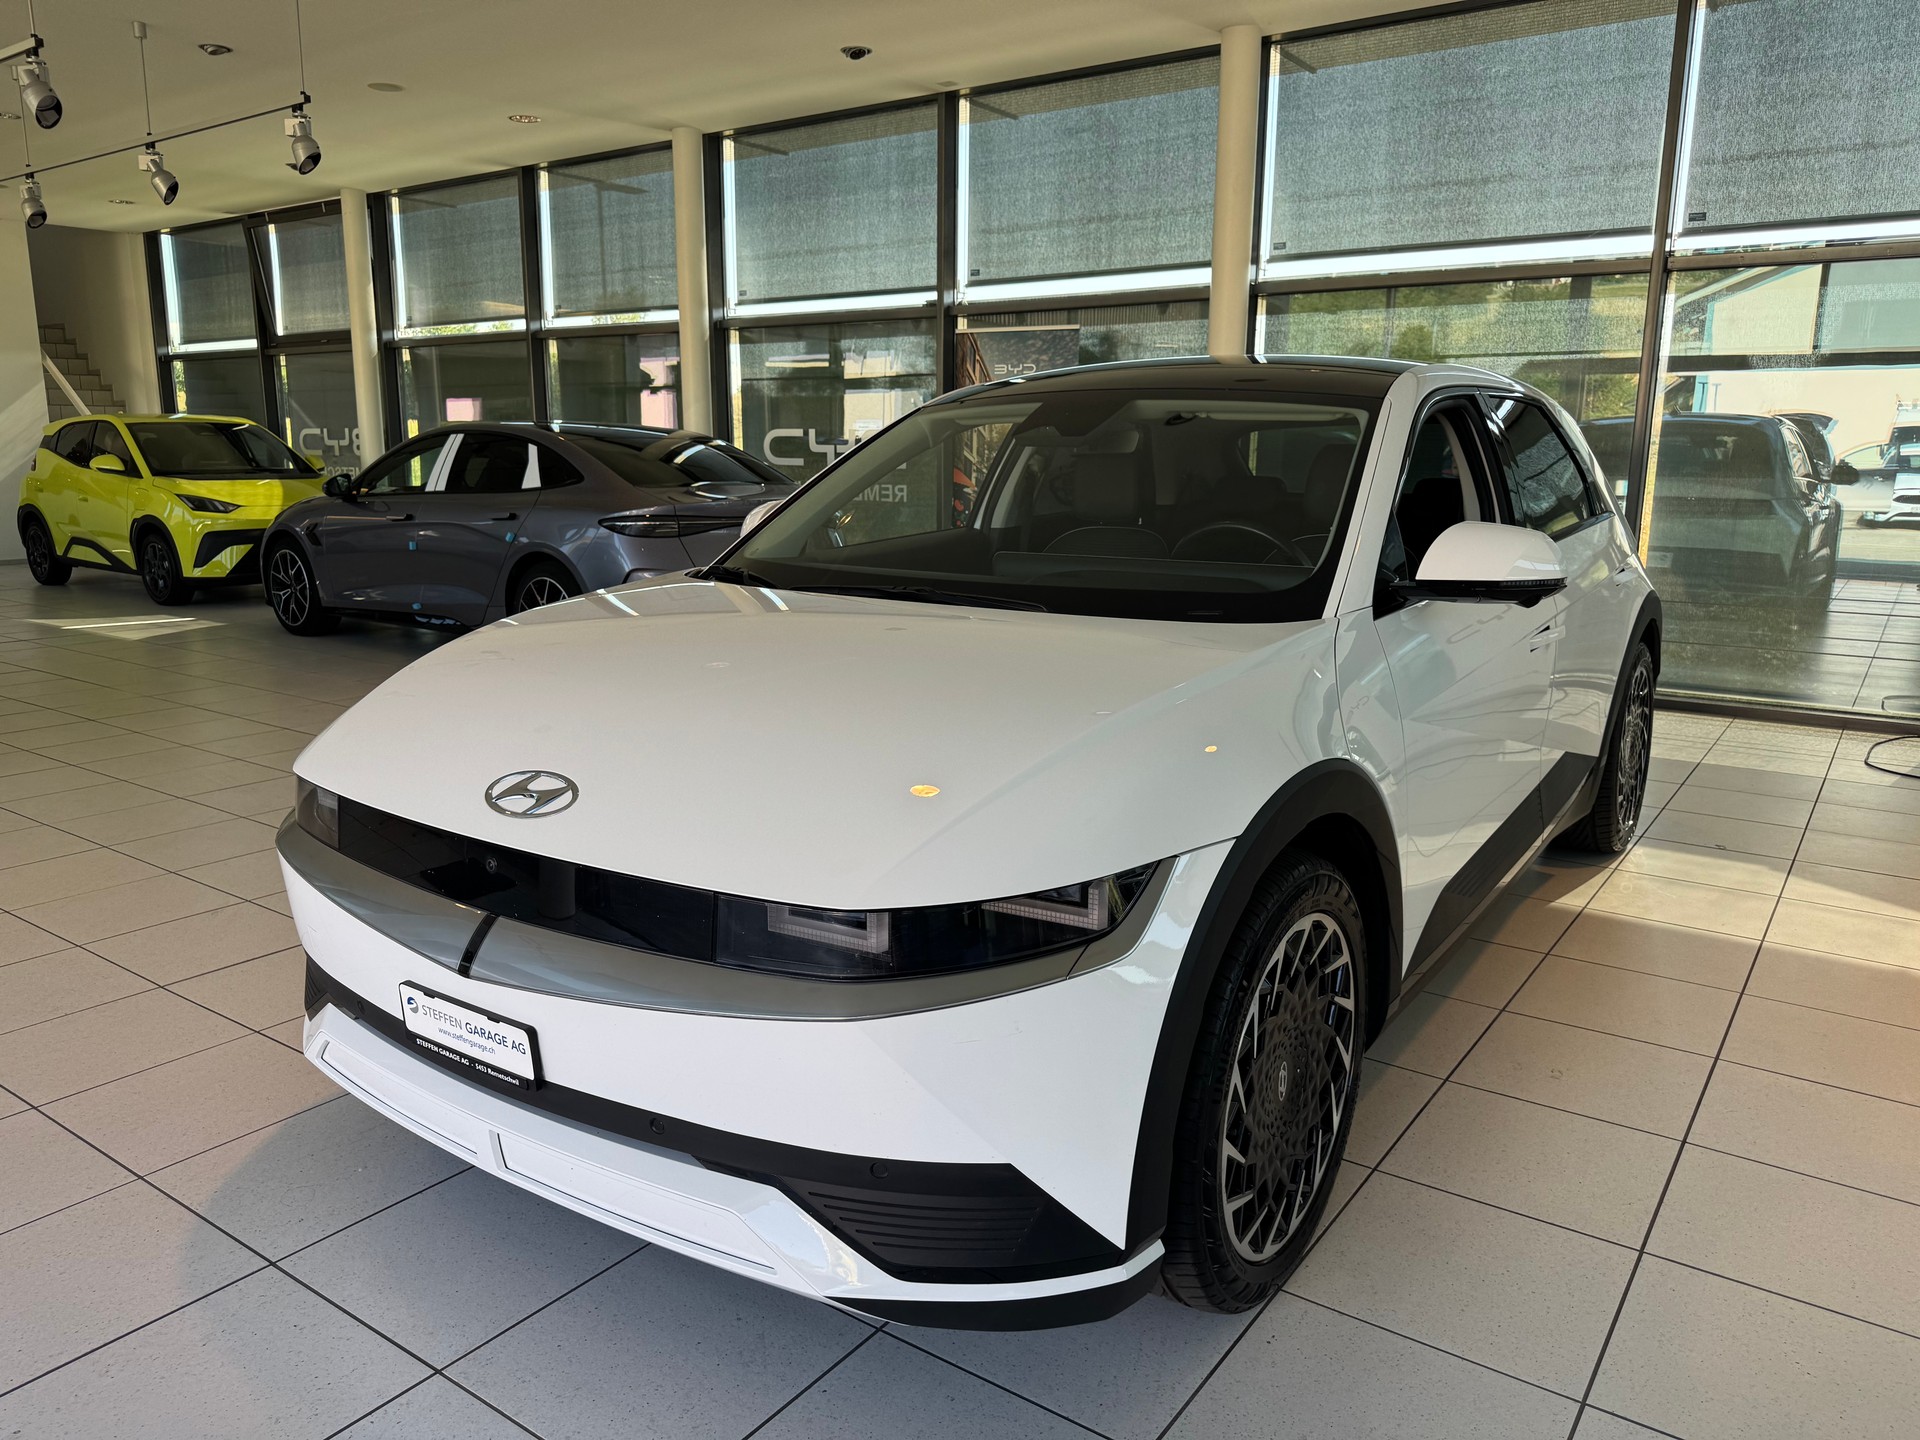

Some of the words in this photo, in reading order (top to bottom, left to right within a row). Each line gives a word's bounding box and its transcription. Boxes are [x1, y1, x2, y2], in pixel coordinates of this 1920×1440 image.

[994, 363, 1036, 375] BYD
[421, 1004, 463, 1031] STEFFEN
[464, 1022, 509, 1048] GARAGE
[511, 1040, 526, 1055] AG
[438, 1027, 496, 1055] www.steffengarage.ch
[416, 1038, 439, 1053] STEFFEN
[439, 1048, 461, 1063] GARAGE
[461, 1057, 470, 1066] AG
[487, 1068, 520, 1086] Remetschwil
